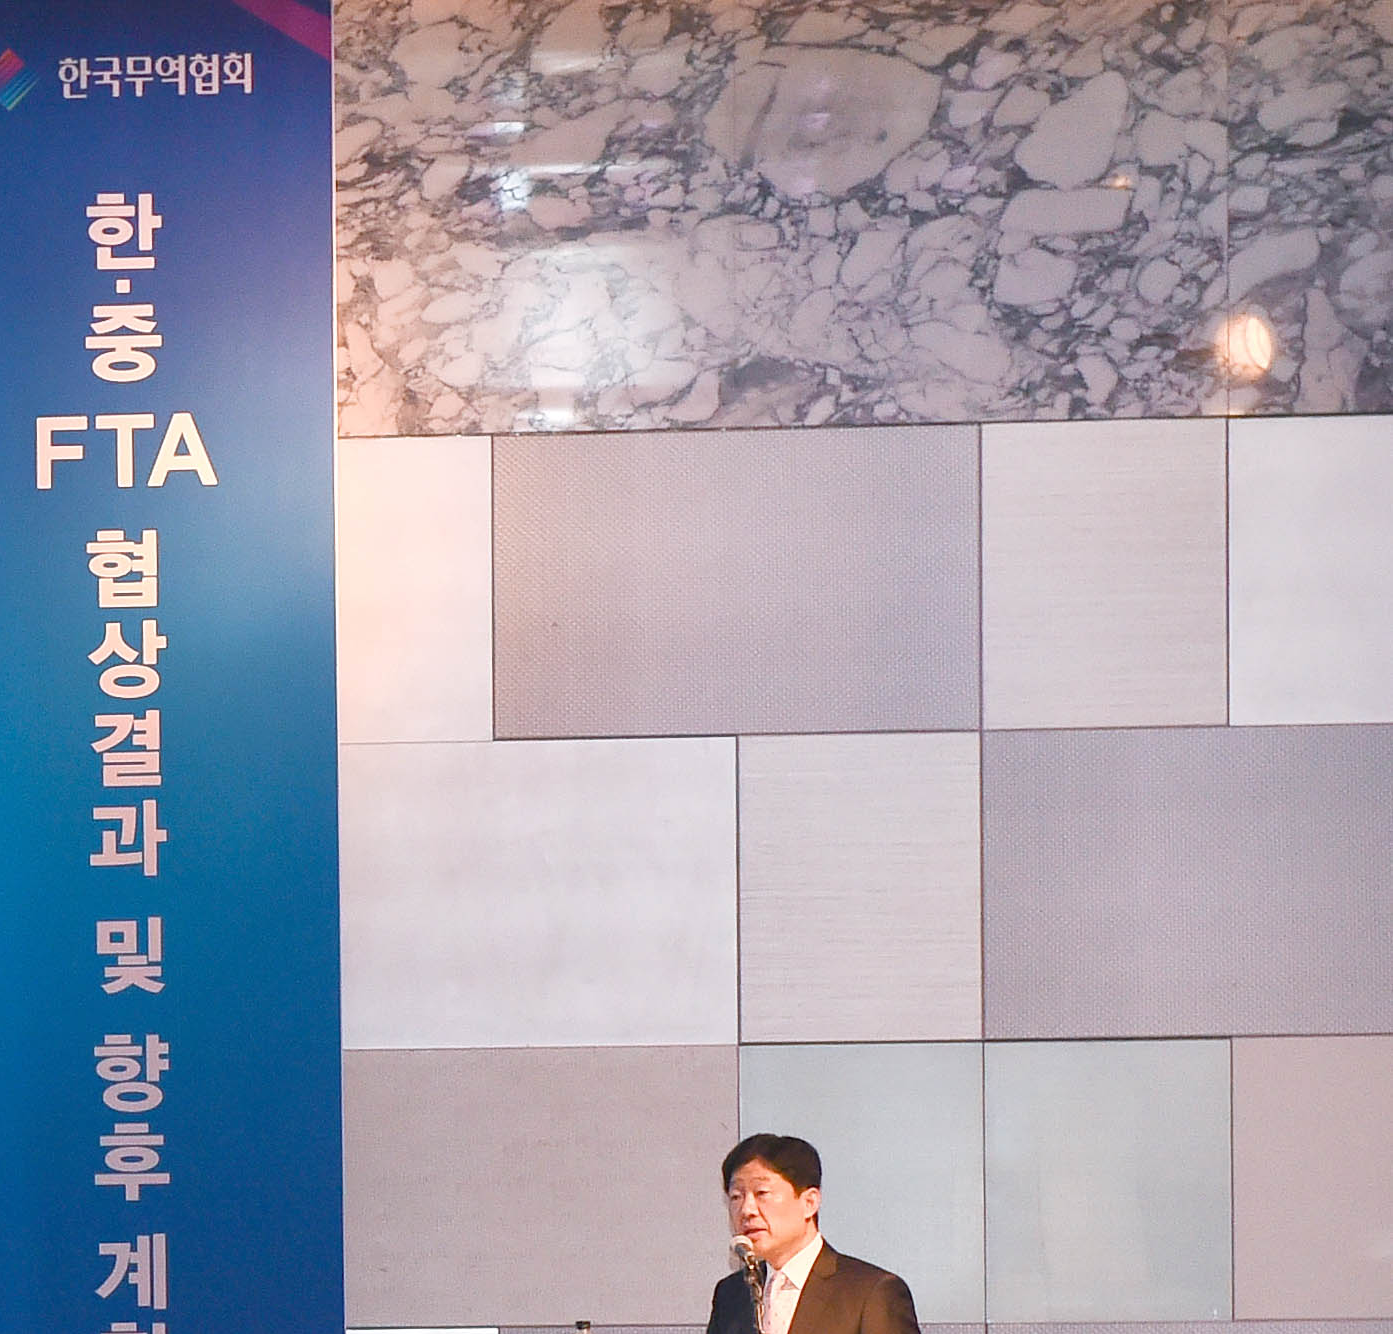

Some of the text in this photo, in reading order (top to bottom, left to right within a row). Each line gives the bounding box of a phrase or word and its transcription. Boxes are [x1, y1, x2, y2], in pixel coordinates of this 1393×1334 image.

[59, 53, 252, 98] 한국무역협회
[35, 411, 219, 490] FTA
[95, 916, 166, 995] 및
[93, 1034, 171, 1201] 향후
